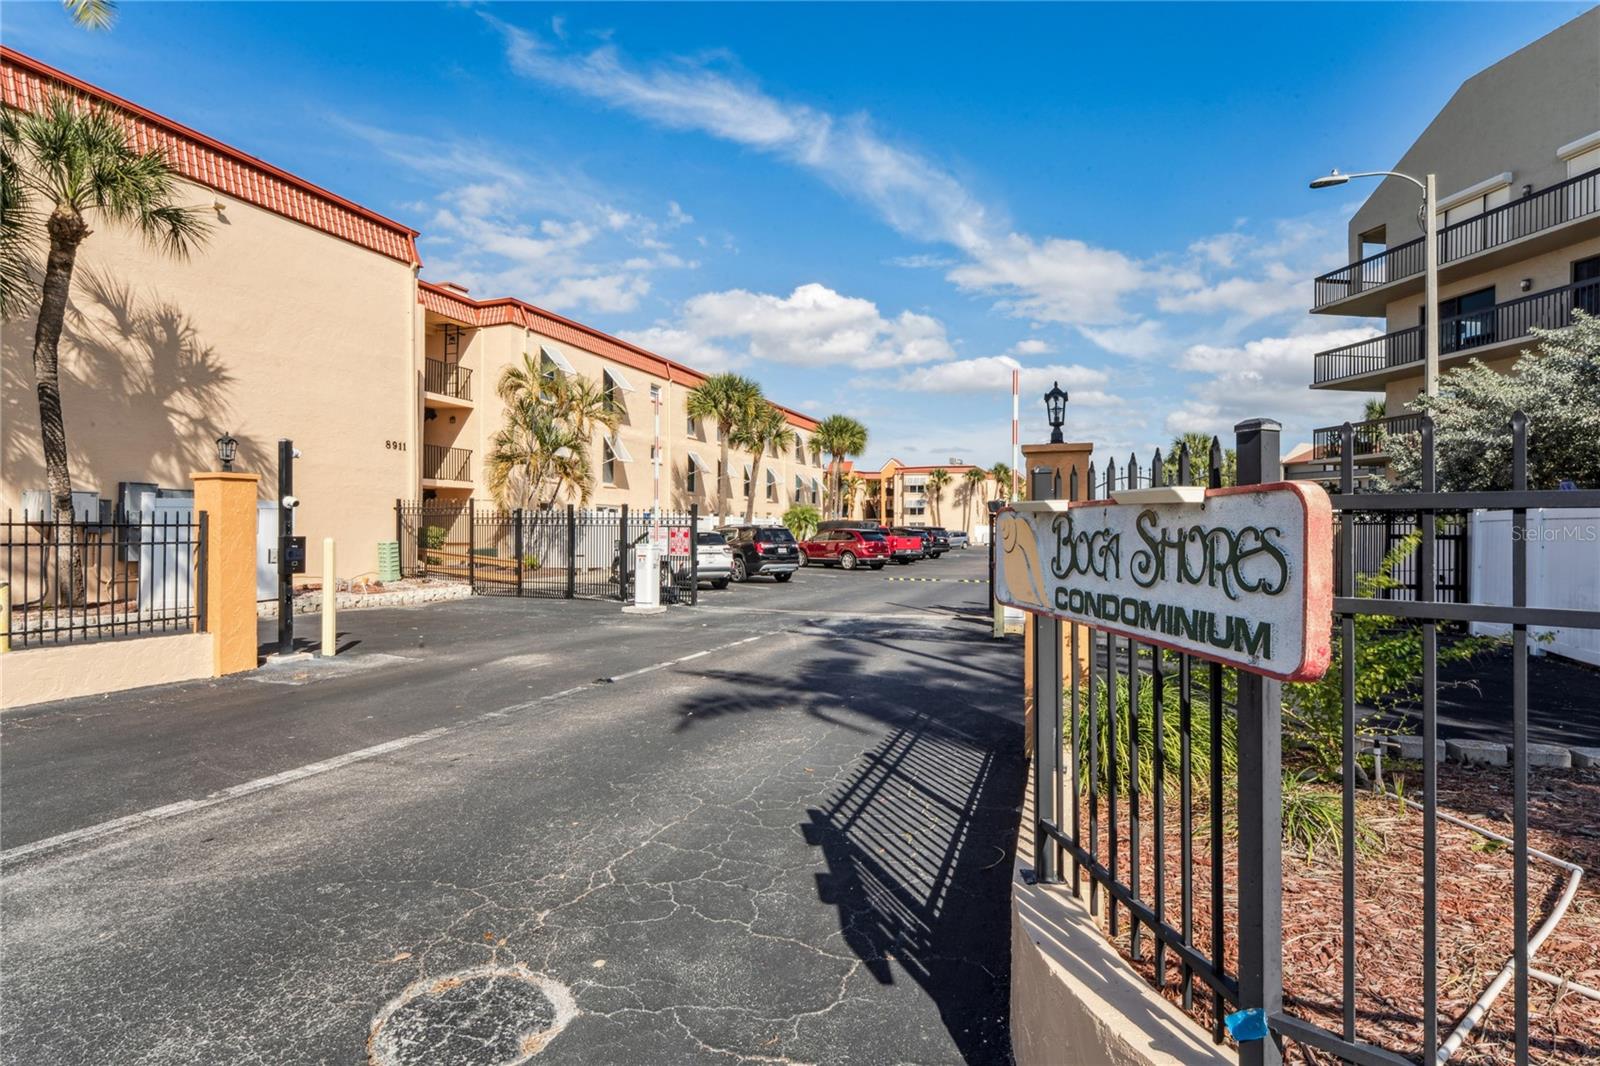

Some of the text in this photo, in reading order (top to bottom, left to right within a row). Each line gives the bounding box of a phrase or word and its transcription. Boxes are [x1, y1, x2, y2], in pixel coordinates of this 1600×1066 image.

[385, 440, 407, 452] 8911
[1051, 509, 1288, 600] BOCA SHORES
[1055, 588, 1270, 660] CONDOMINIUM
